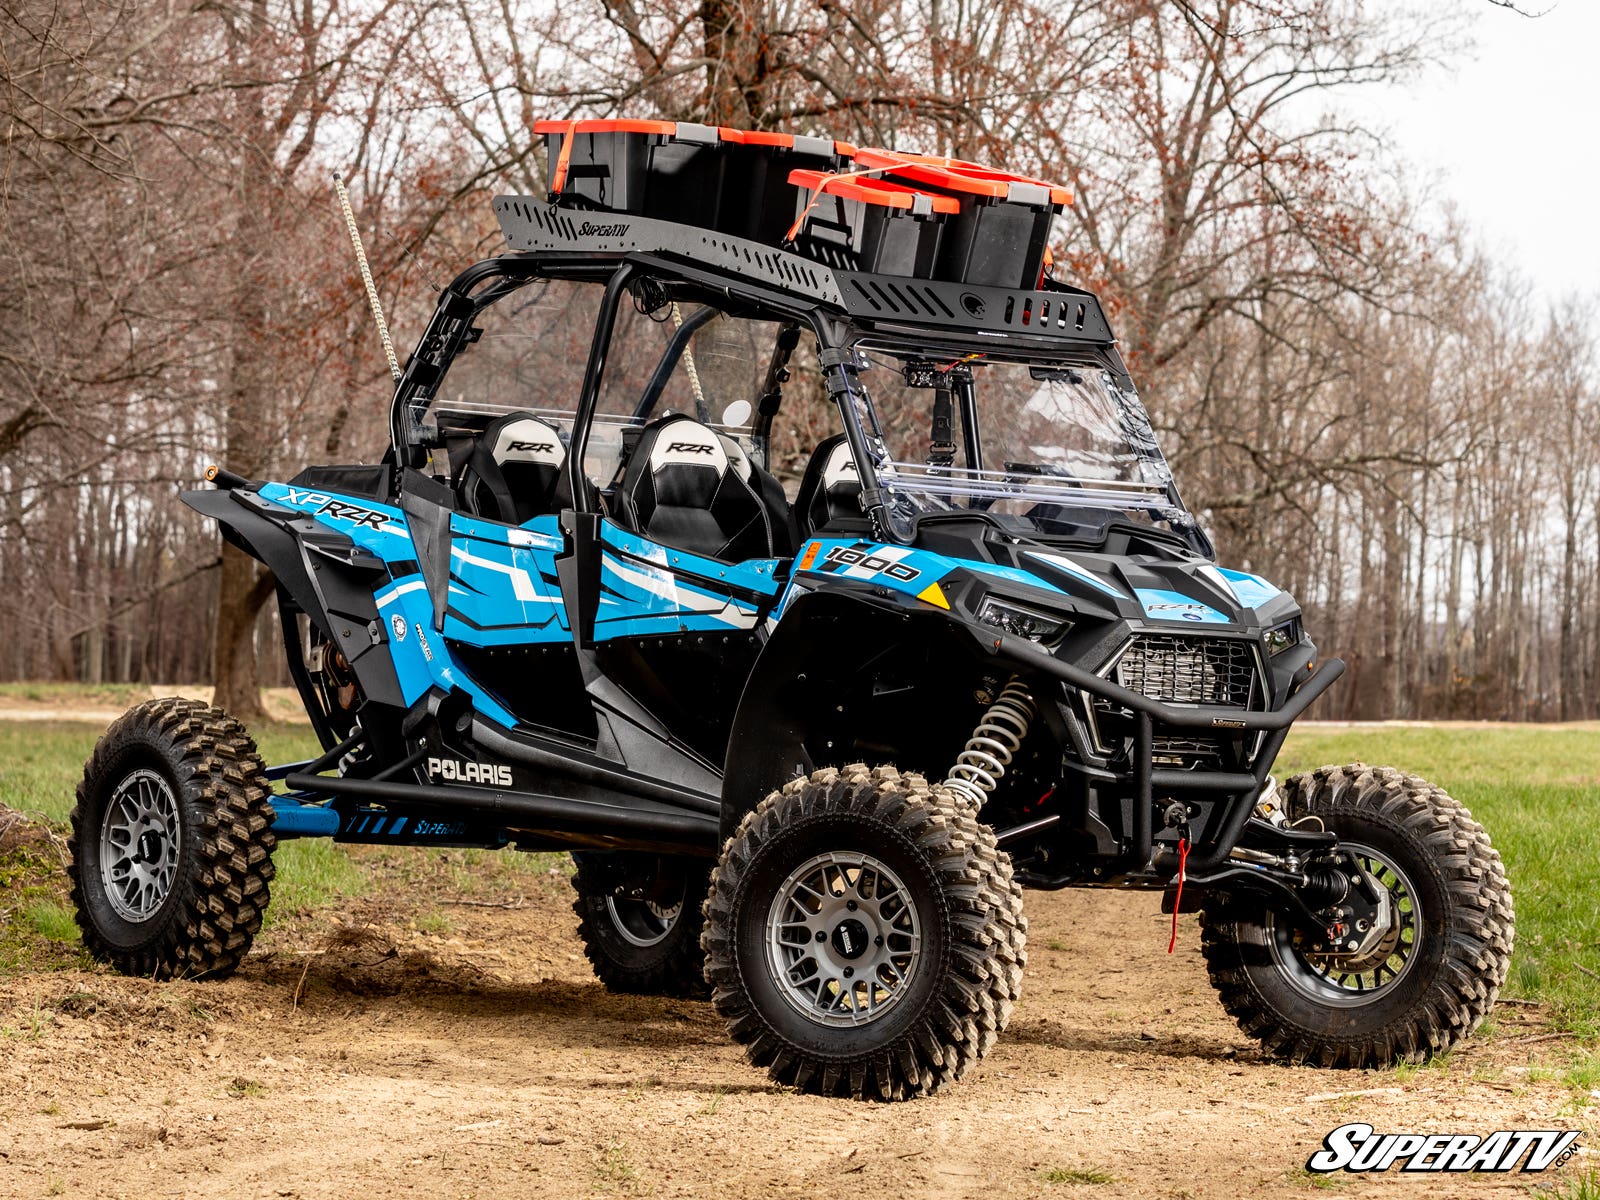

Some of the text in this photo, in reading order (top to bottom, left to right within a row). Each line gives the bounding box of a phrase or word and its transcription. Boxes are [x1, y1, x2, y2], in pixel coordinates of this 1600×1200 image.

[506, 441, 556, 454] RZR
[665, 442, 715, 456] RZR
[277, 487, 390, 532] XP RZR
[823, 546, 921, 582] 1000
[428, 757, 513, 786] POLARIS
